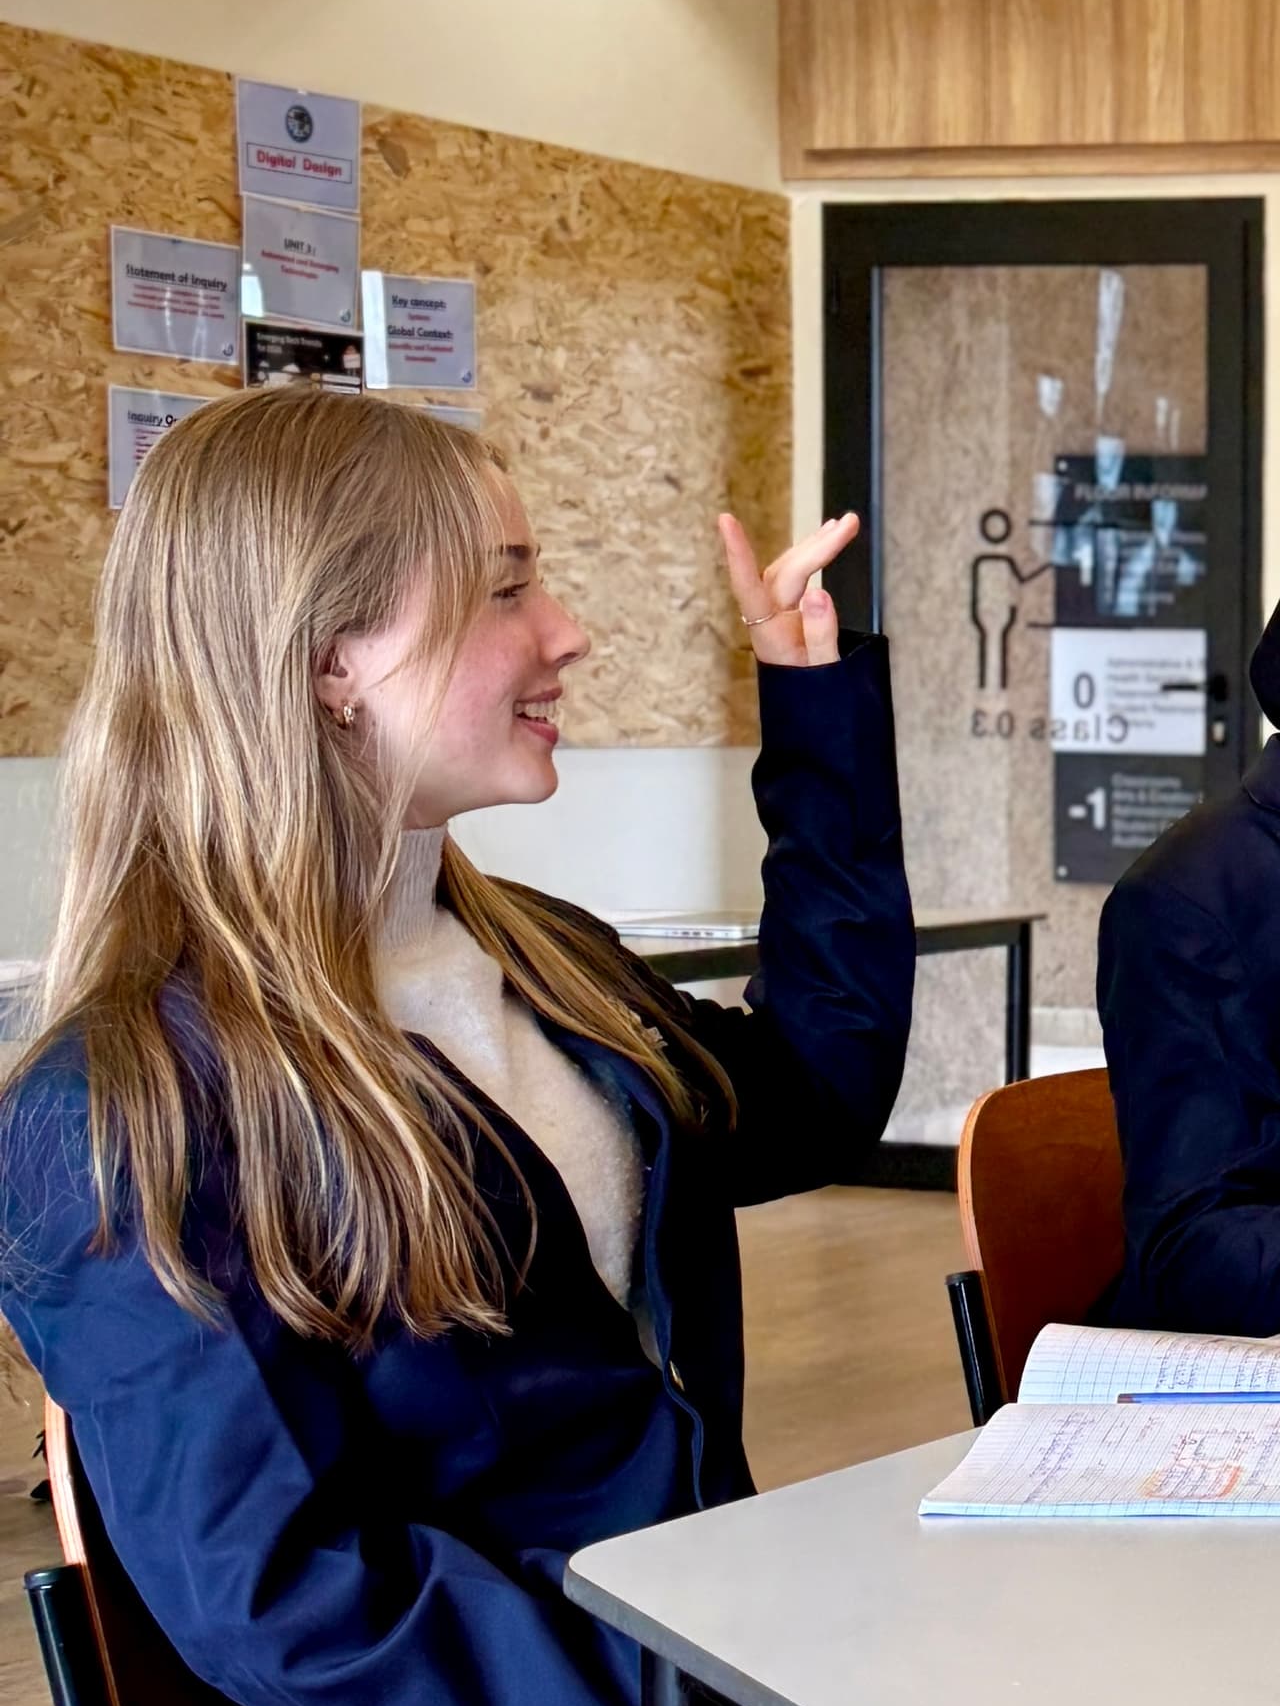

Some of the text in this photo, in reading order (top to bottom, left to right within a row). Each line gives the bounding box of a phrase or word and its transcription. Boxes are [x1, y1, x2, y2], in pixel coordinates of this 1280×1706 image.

[256, 149, 343, 178] Digital Design
[126, 264, 227, 293] Statement of Inquiry
[392, 294, 408, 309] Key
[387, 324, 416, 338] Global
[127, 410, 163, 426] Inquiry
[1072, 543, 1093, 587] 1
[1073, 671, 1096, 710] 0
